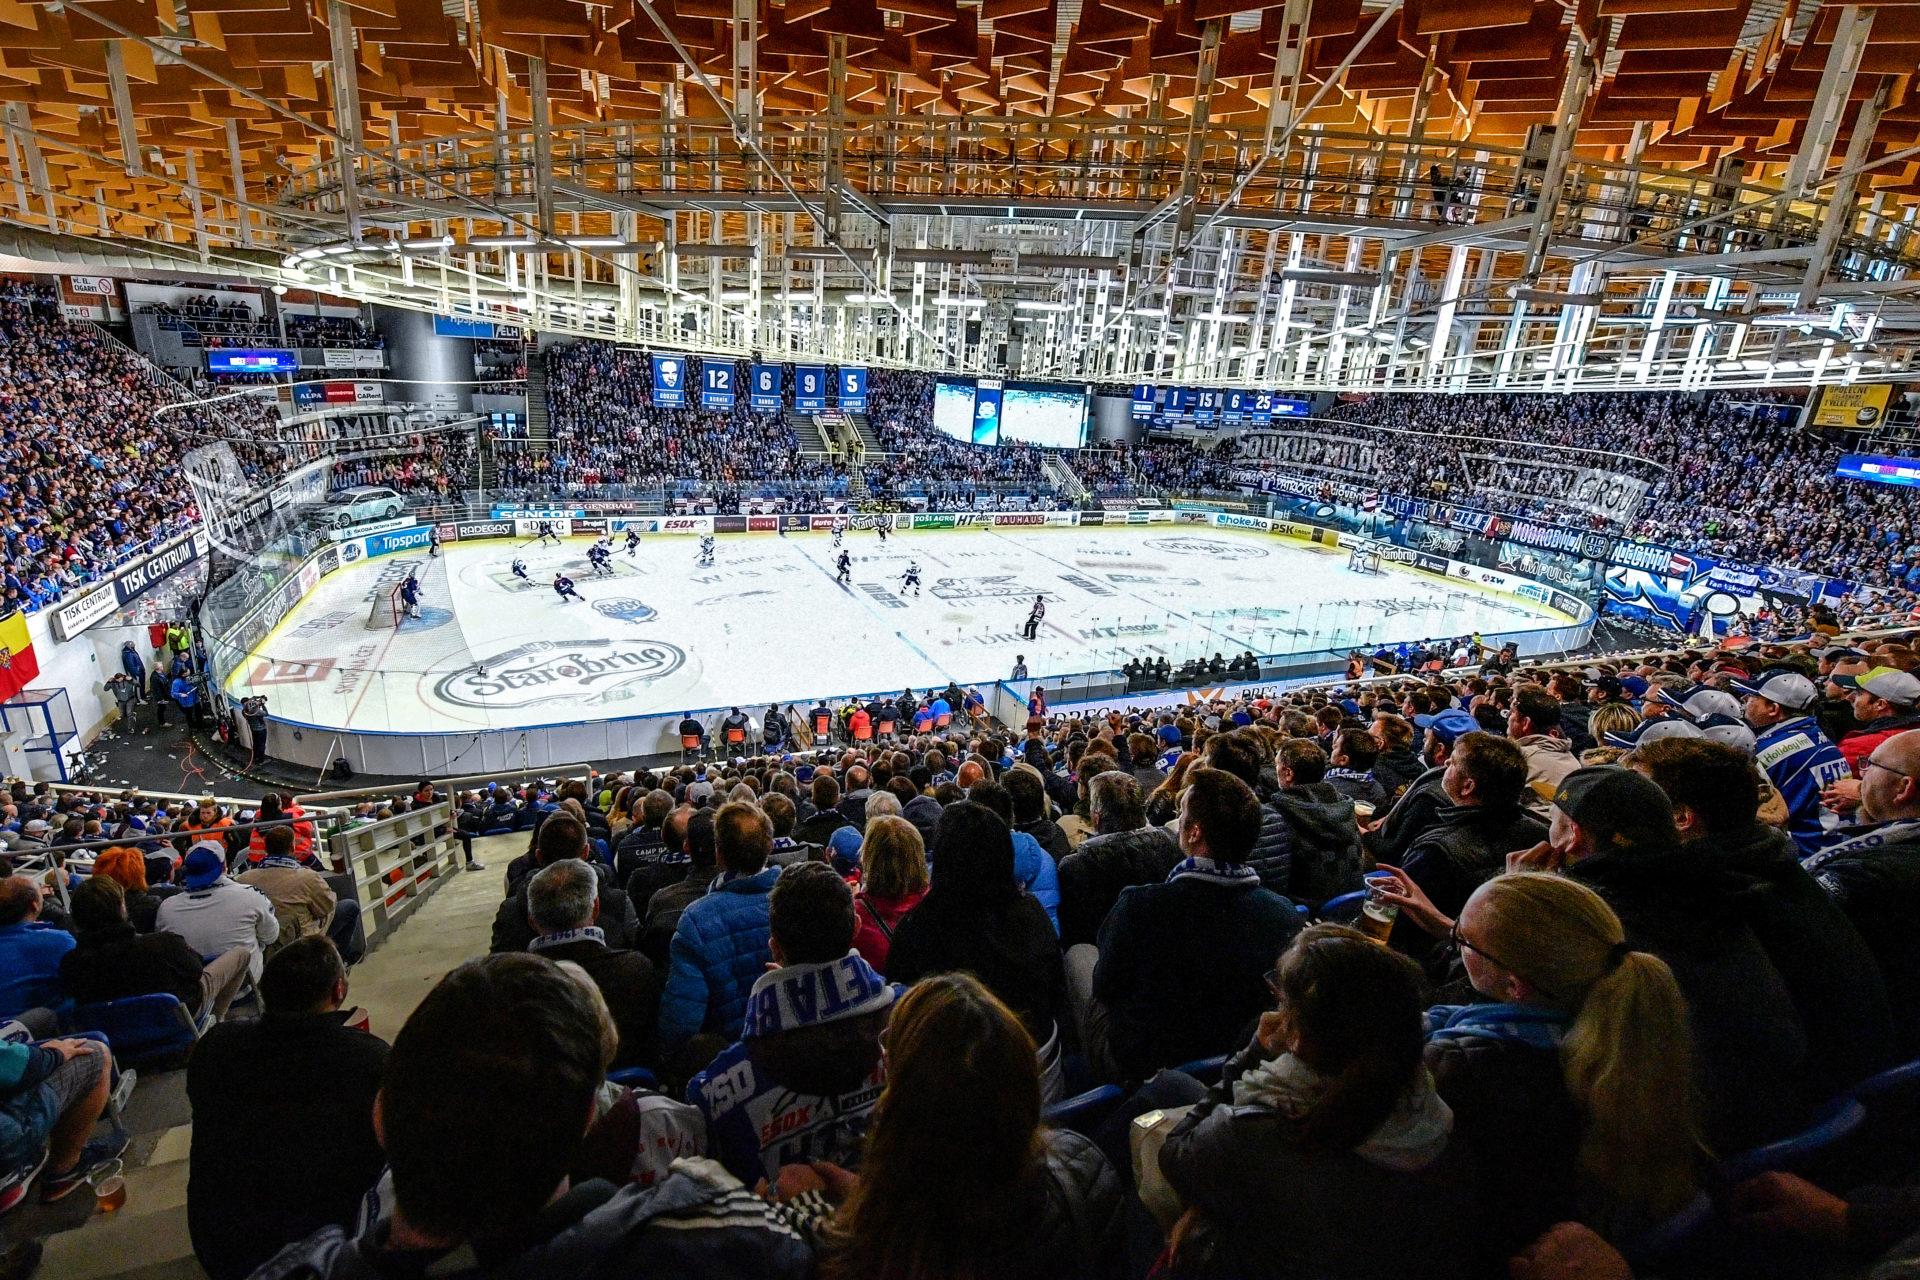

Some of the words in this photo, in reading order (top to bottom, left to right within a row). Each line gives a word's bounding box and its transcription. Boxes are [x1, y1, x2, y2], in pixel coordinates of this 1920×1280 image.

[708, 370, 729, 389] 12
[760, 371, 772, 391] 6
[804, 374, 816, 393] 9
[846, 374, 858, 393] 5
[1142, 386, 1148, 399] 1
[1172, 391, 1179, 406] 1
[1199, 392, 1213, 407] 15
[1231, 394, 1240, 409] 6
[1255, 395, 1271, 410] 25
[1233, 433, 1322, 462] SOUKUP
[1276, 477, 1314, 495] PATRIOTS
[1577, 476, 1642, 512] GROUP
[227, 514, 243, 531] TISK
[530, 520, 564, 531] DFG
[664, 520, 696, 529] ESOX
[813, 519, 832, 527] Auto
[914, 514, 933, 522] ZOŠI
[956, 514, 976, 526] HT
[994, 515, 1045, 525] BAUHAUS
[1226, 514, 1268, 528] hokejka
[196, 531, 206, 544] TISK
[459, 524, 513, 538] RADEGAST
[1271, 523, 1295, 535] PSK
[382, 531, 431, 550] Tipsport
[1421, 530, 1464, 552] Sport
[120, 568, 148, 595] TISK
[147, 541, 192, 580] CENTRUM
[1519, 560, 1572, 585] IMPULS
[63, 604, 82, 621] TISK
[81, 586, 113, 612] CENTRUM
[464, 647, 668, 697] Starobrno
[1763, 740, 1800, 763] Holiday
[1820, 762, 1842, 782] HT
[760, 1102, 815, 1147] ESOX
